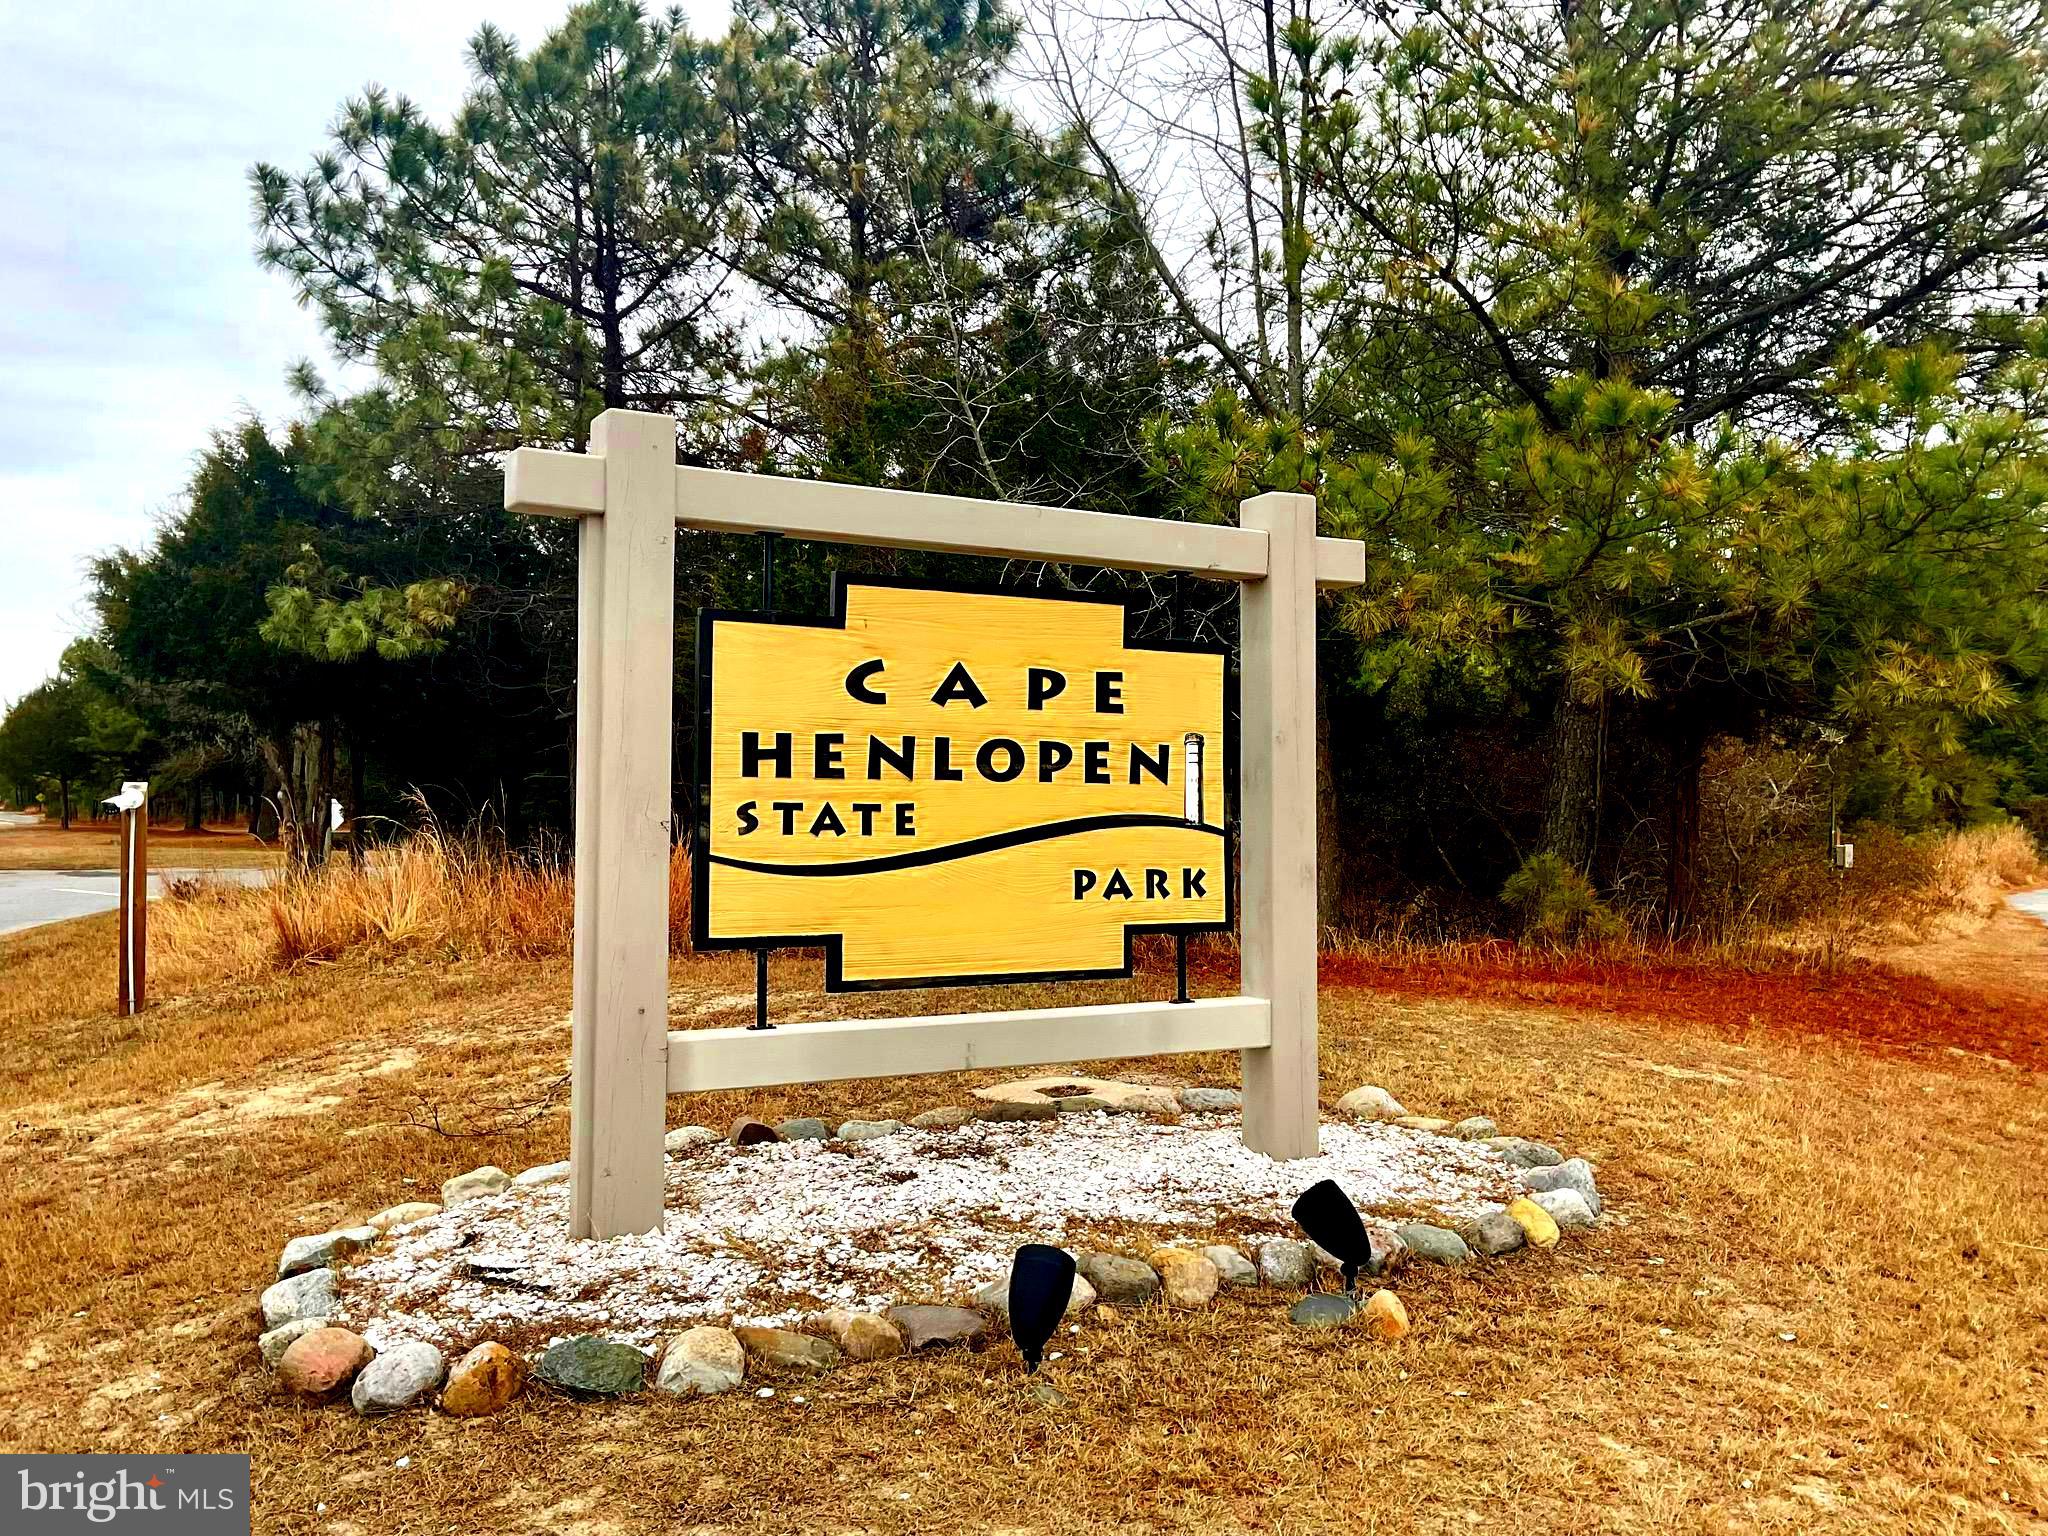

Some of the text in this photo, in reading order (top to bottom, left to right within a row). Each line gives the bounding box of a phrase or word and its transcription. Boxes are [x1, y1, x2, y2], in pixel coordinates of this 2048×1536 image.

[845, 658, 1125, 715] CAPE
[741, 731, 1170, 786] HENLOPEN
[736, 800, 916, 837] STATE
[1074, 868, 1207, 901] PARK
